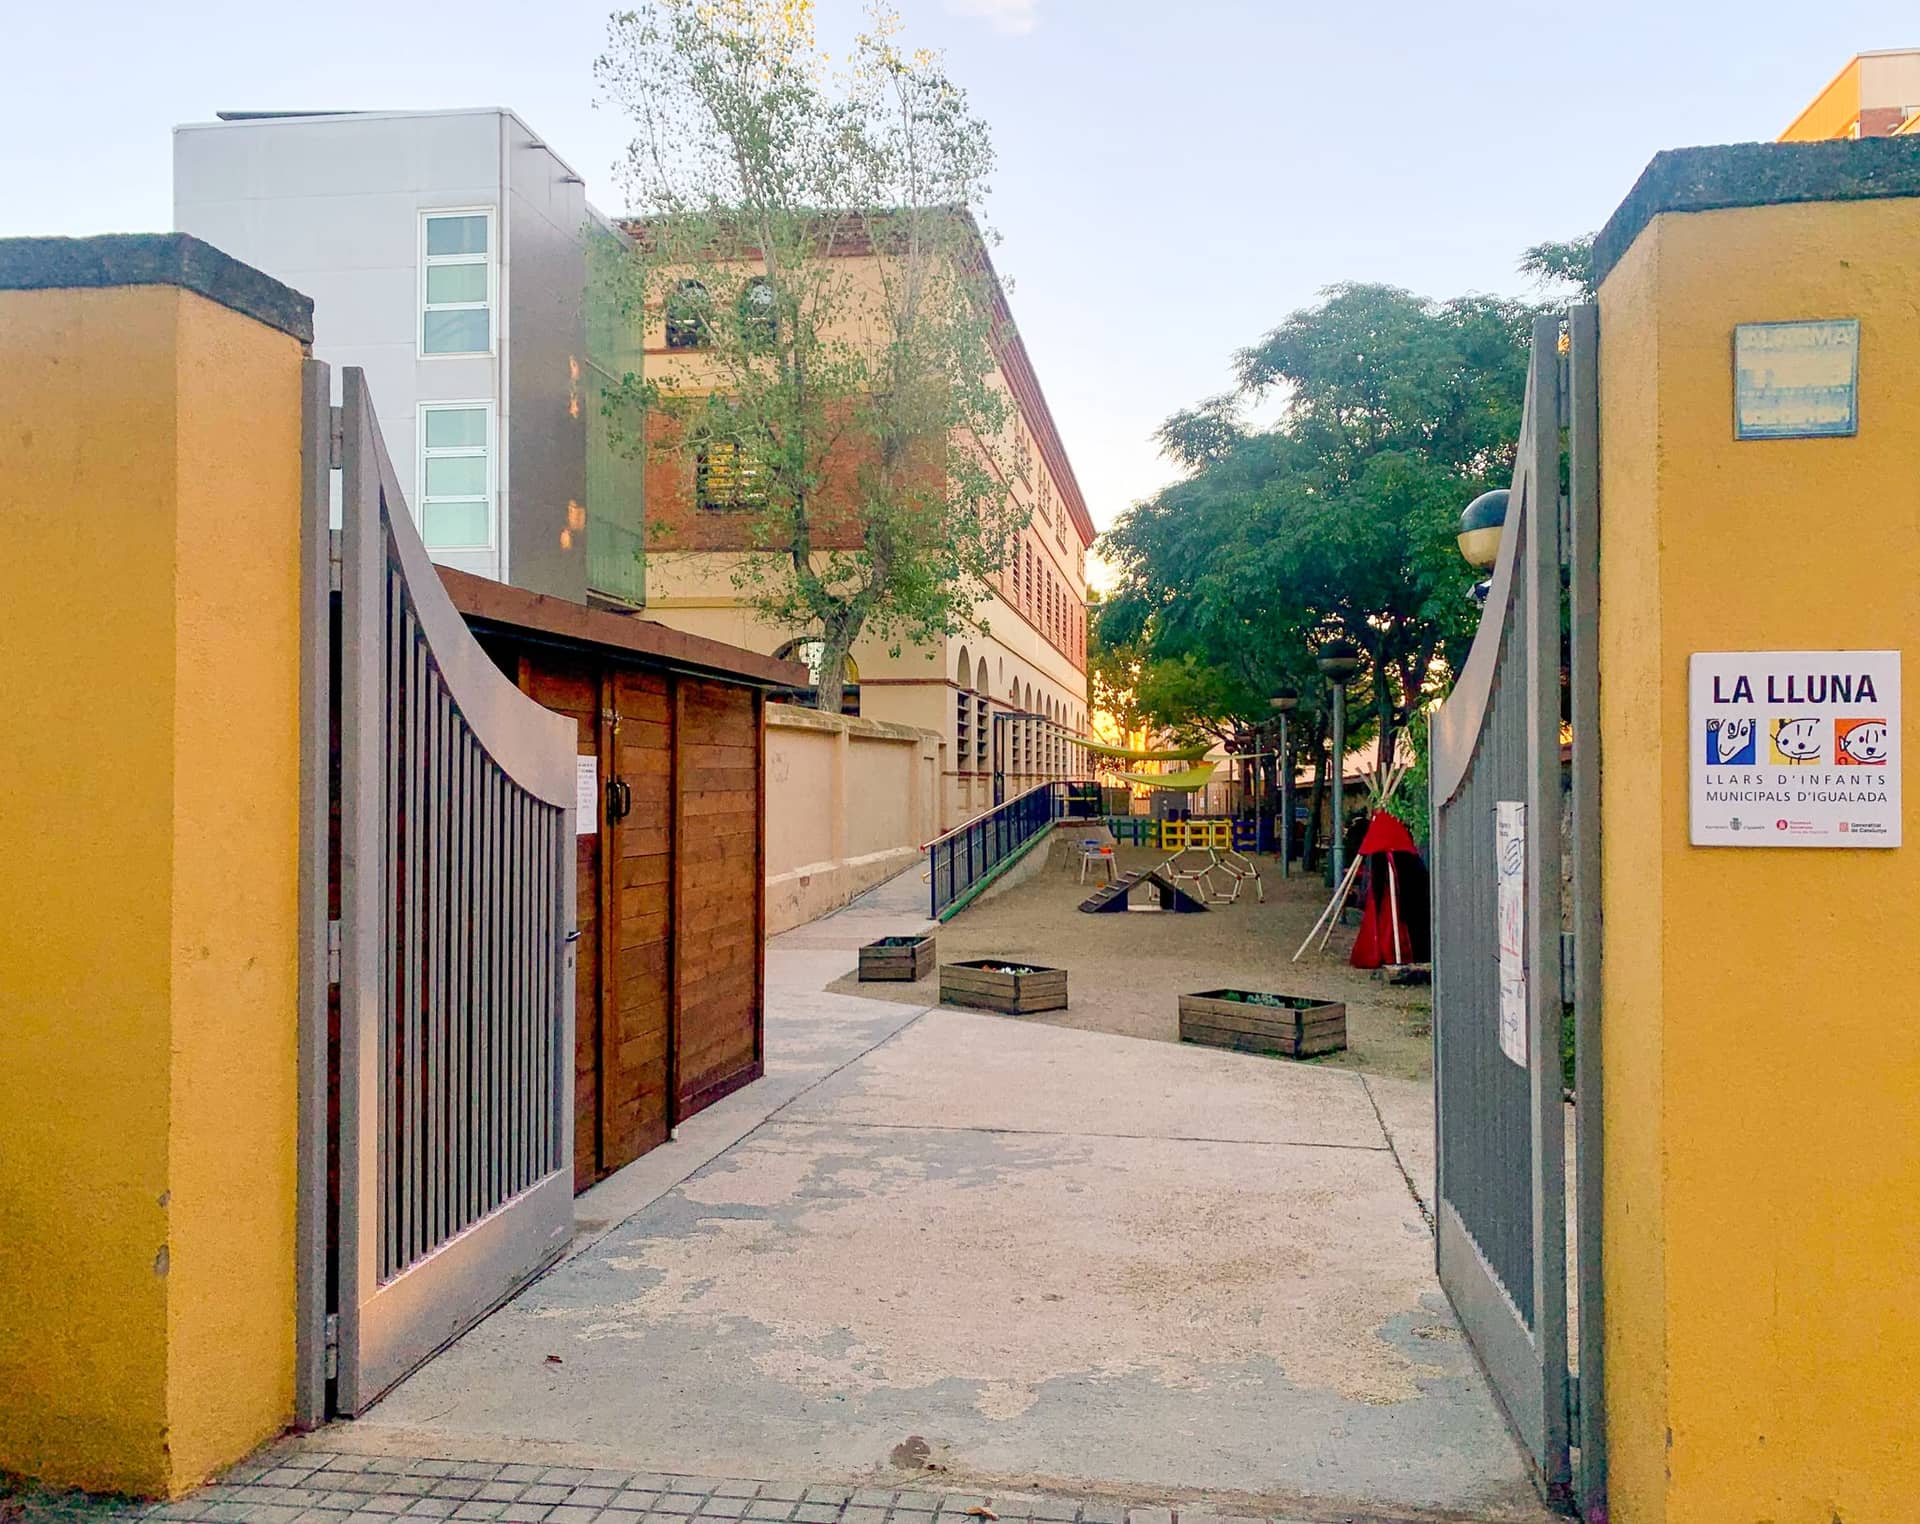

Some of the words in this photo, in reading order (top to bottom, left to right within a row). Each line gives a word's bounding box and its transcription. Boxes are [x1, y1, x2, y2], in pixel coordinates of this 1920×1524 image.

[1713, 675, 1754, 704] LA
[1767, 674, 1878, 704] LLUNA
[1706, 774, 1764, 785] LLARS
[1777, 774, 1886, 785] D'INFANTS
[1706, 791, 1791, 802] MUNICIPALS
[1797, 791, 1888, 802] D'IGUALADA
